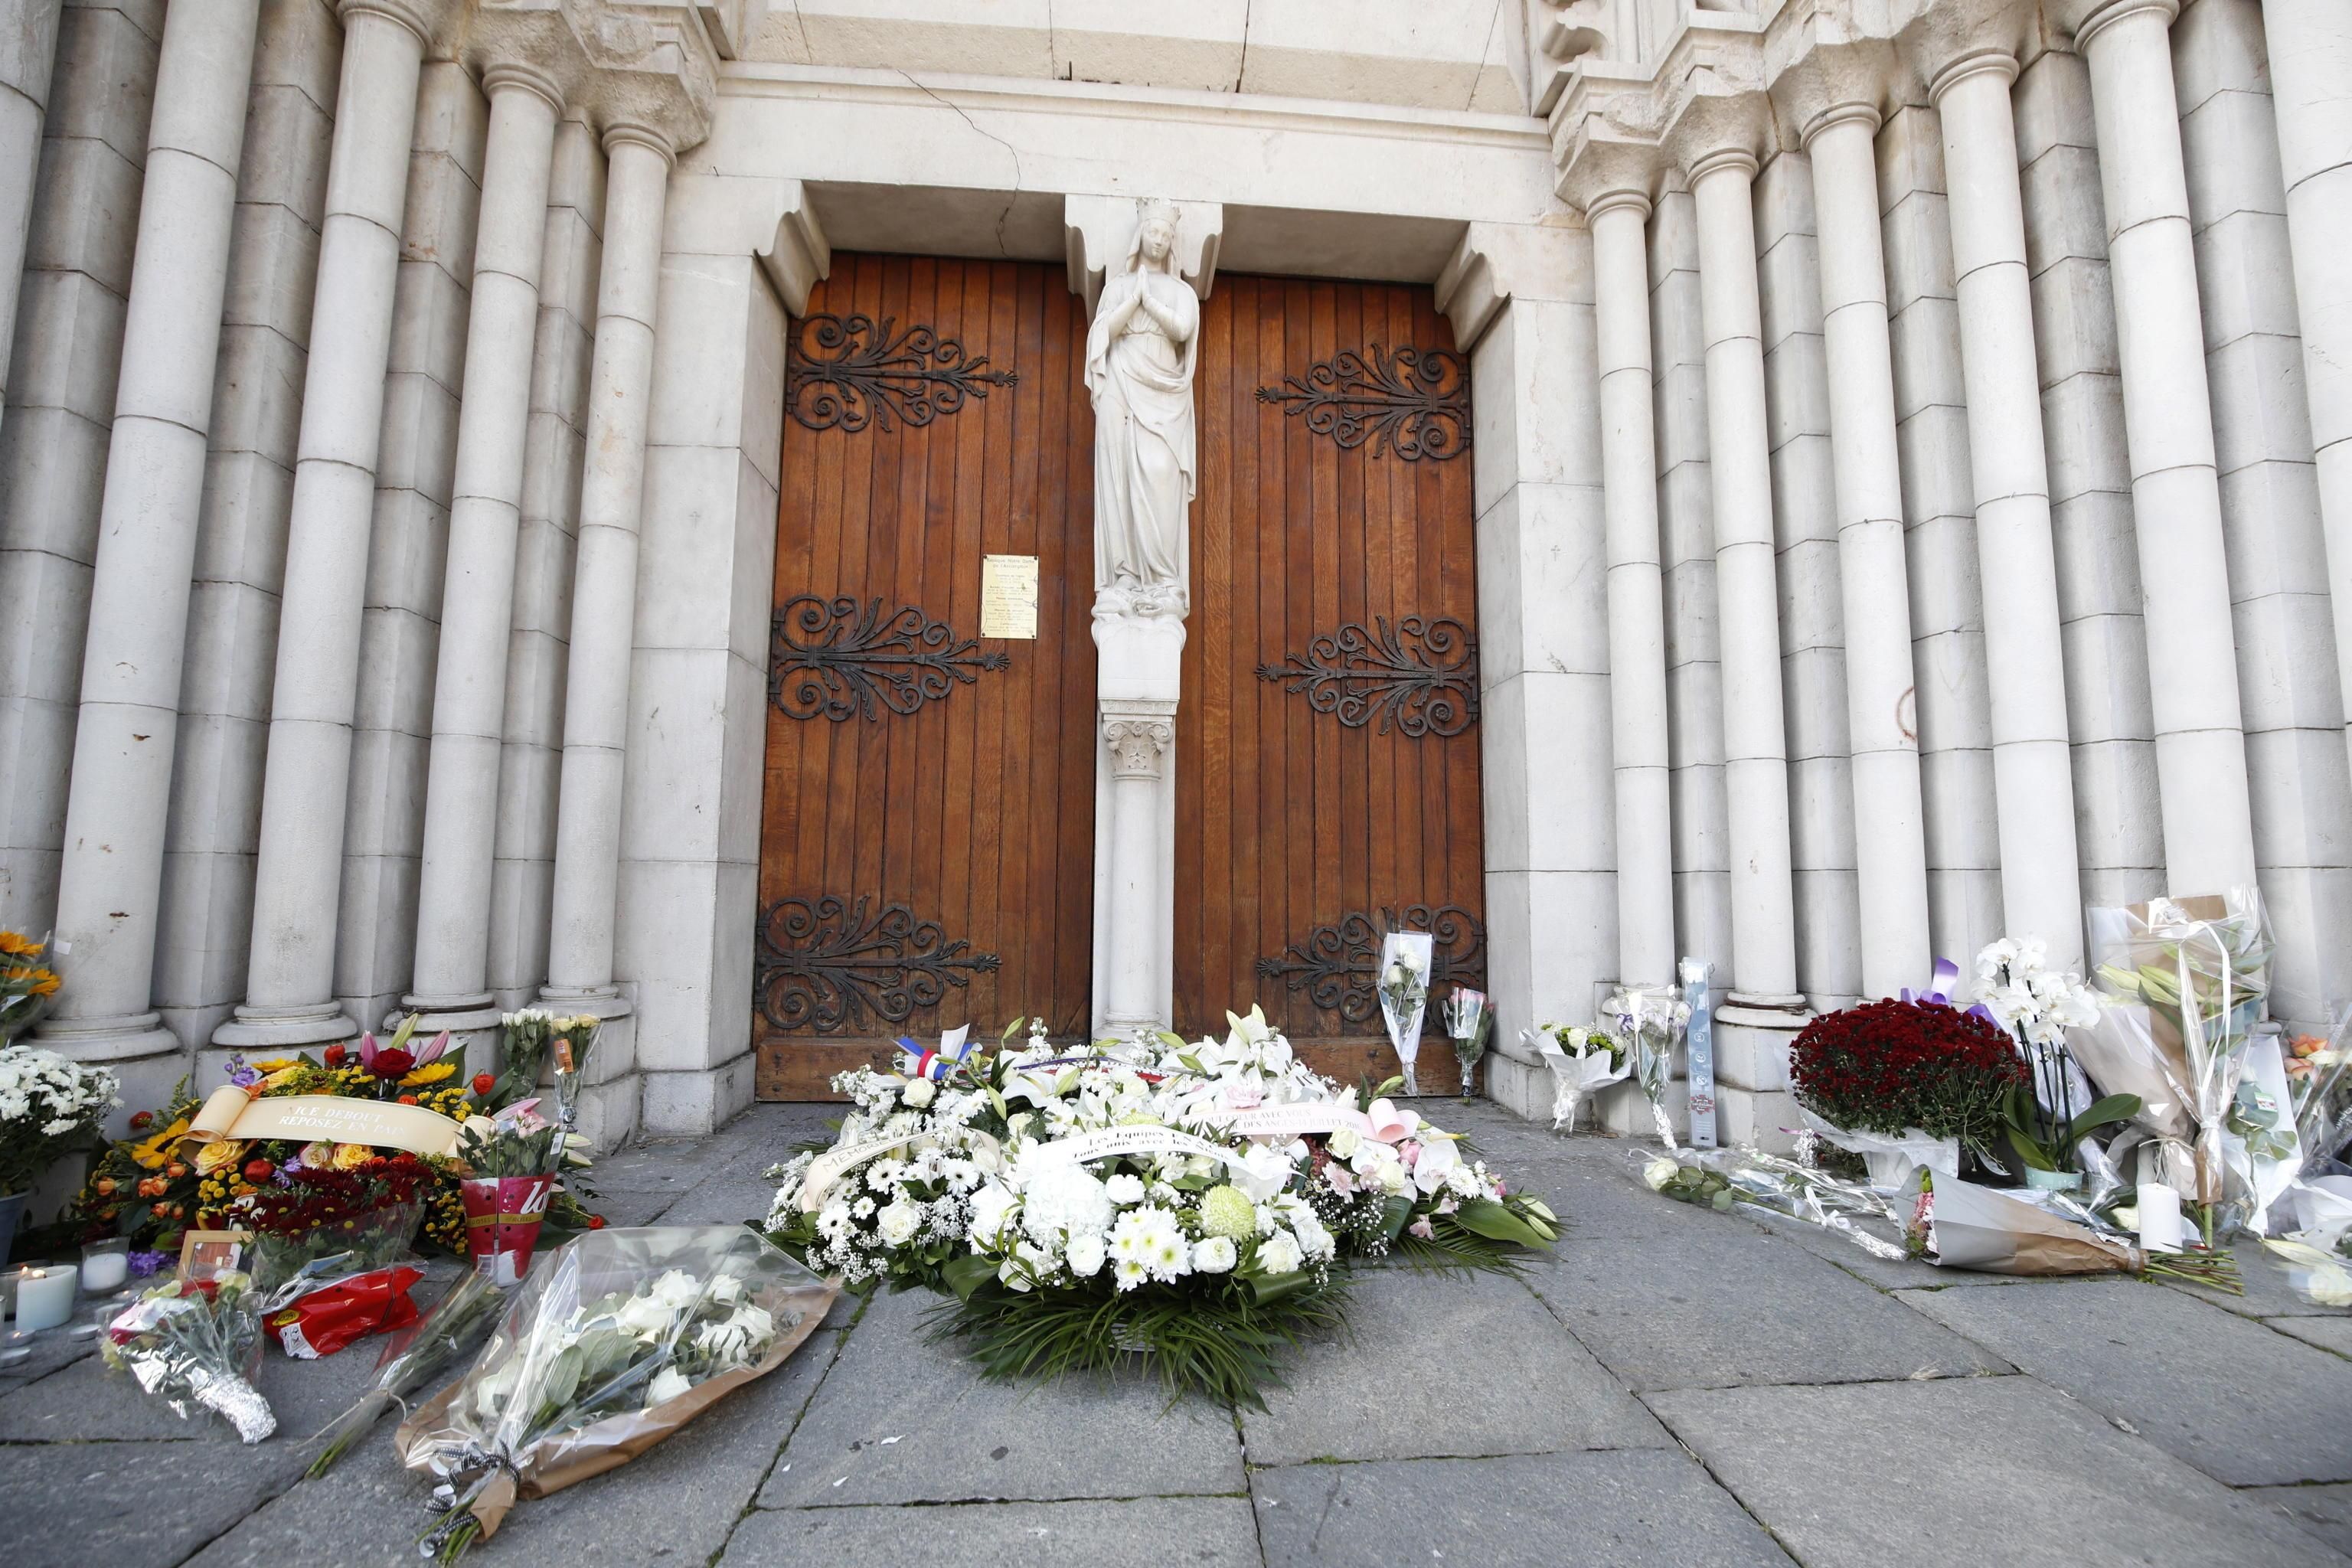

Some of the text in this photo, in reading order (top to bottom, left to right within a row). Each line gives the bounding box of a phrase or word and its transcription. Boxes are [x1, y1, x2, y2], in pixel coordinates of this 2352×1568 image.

[325, 1109, 384, 1122] DEBOUT
[1261, 1110, 1282, 1119] AVEC
[1285, 1108, 1312, 1117] VOUS
[278, 1116, 344, 1129] REPOSEZ
[348, 1122, 368, 1131] EN
